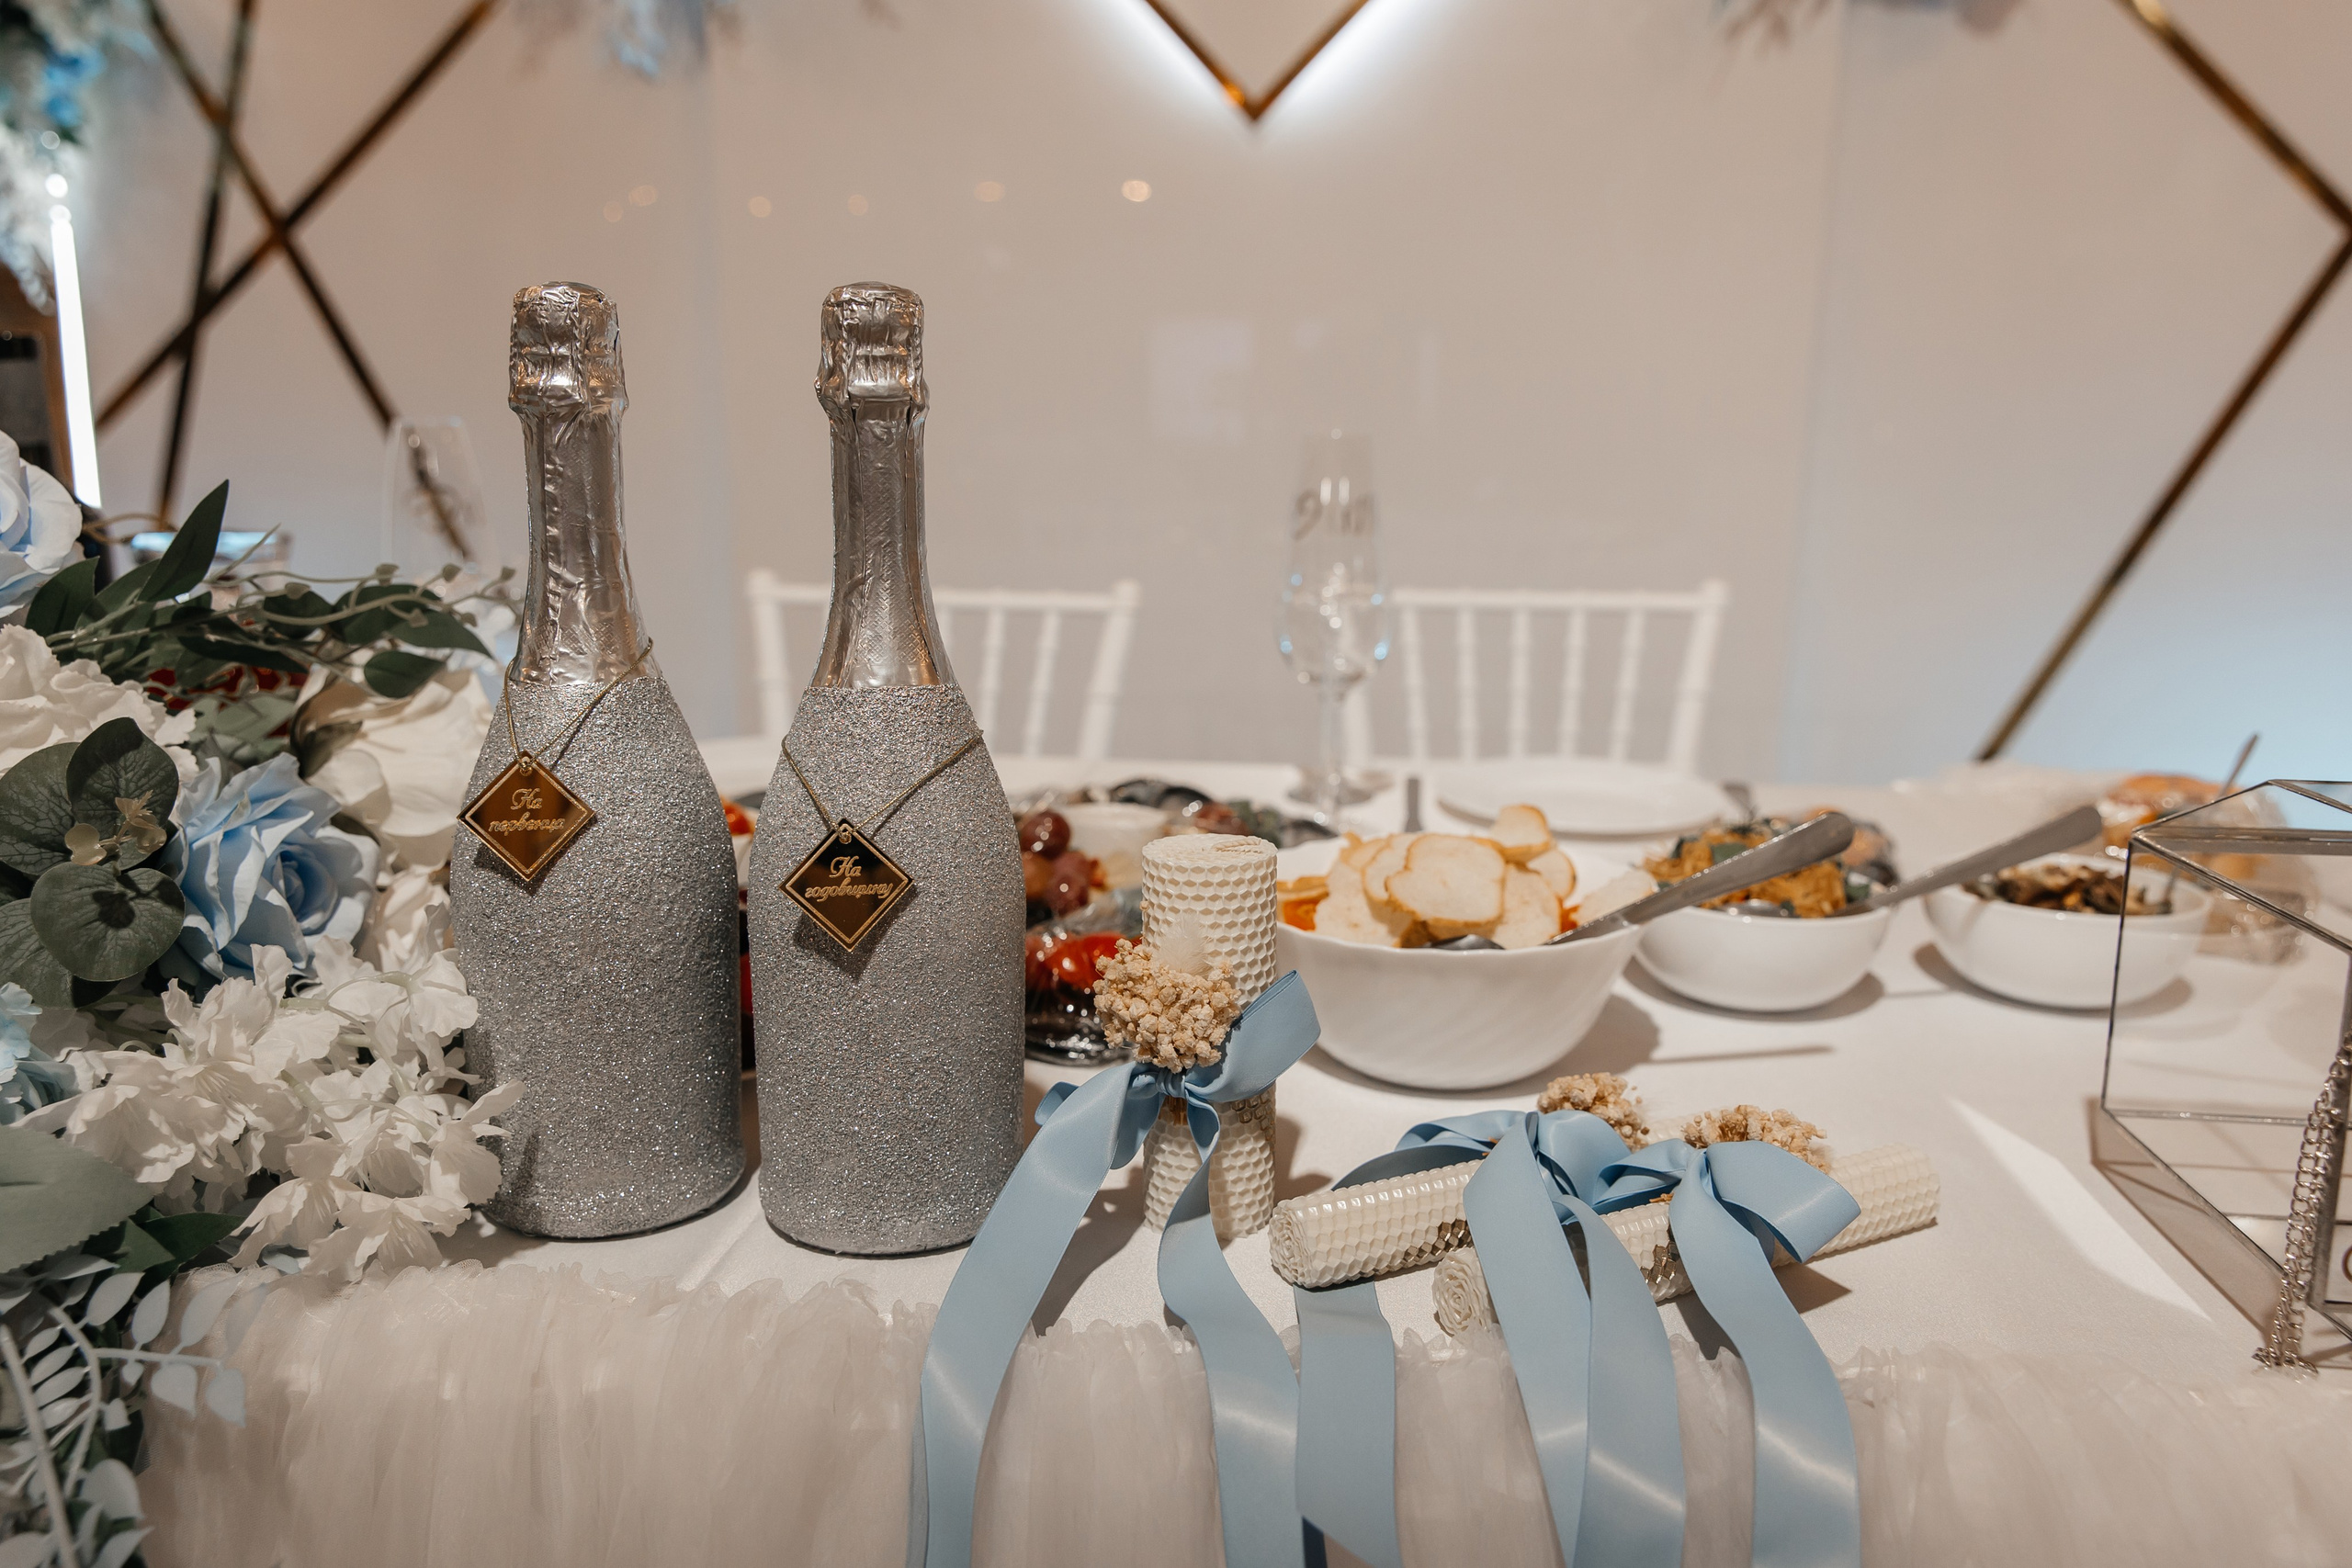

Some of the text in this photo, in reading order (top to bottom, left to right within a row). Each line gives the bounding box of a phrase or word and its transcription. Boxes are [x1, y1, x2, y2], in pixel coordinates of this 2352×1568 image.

[510, 787, 543, 810] На
[829, 855, 862, 878] На
[805, 877, 893, 902] годовщину
